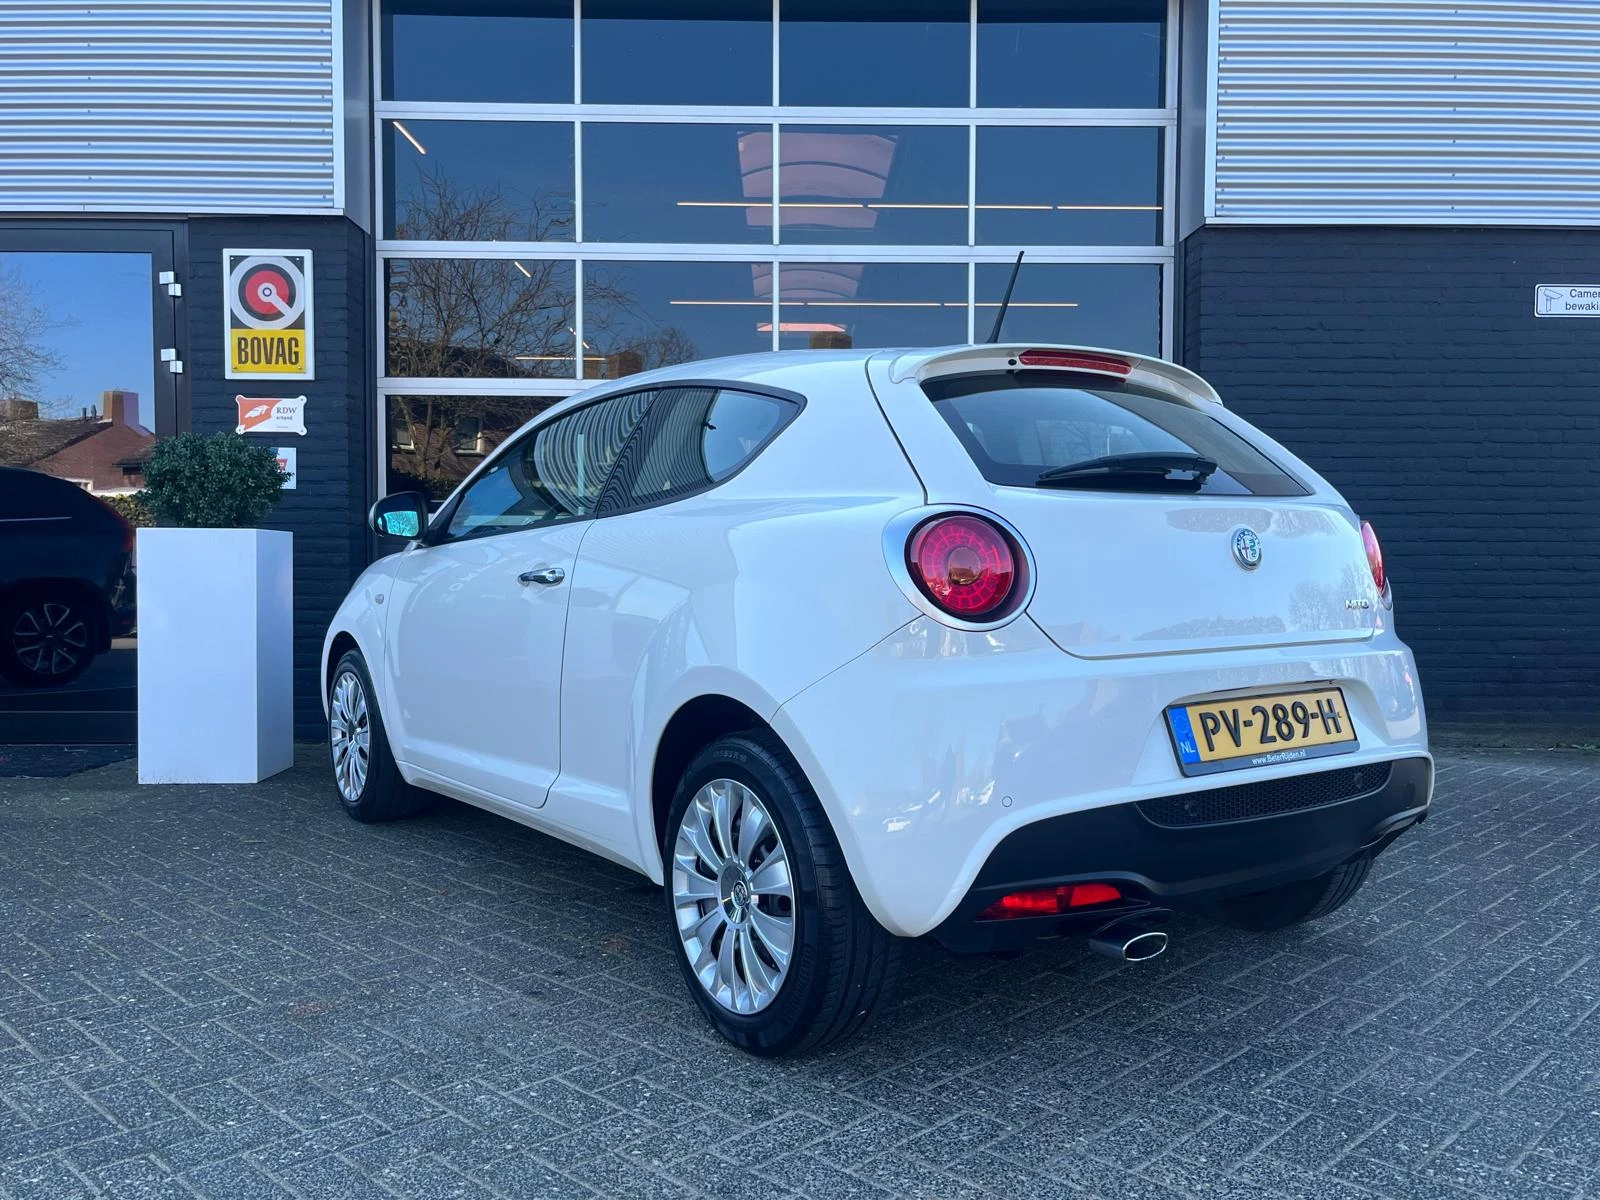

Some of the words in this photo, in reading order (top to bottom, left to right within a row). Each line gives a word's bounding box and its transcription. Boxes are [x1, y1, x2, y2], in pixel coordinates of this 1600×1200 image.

[237, 336, 300, 365] BOVAG
[276, 406, 297, 414] RDW
[1199, 698, 1342, 752] PV-289-H
[1180, 741, 1196, 754] NL
[1251, 748, 1306, 765] www.BeterRijden.nl
